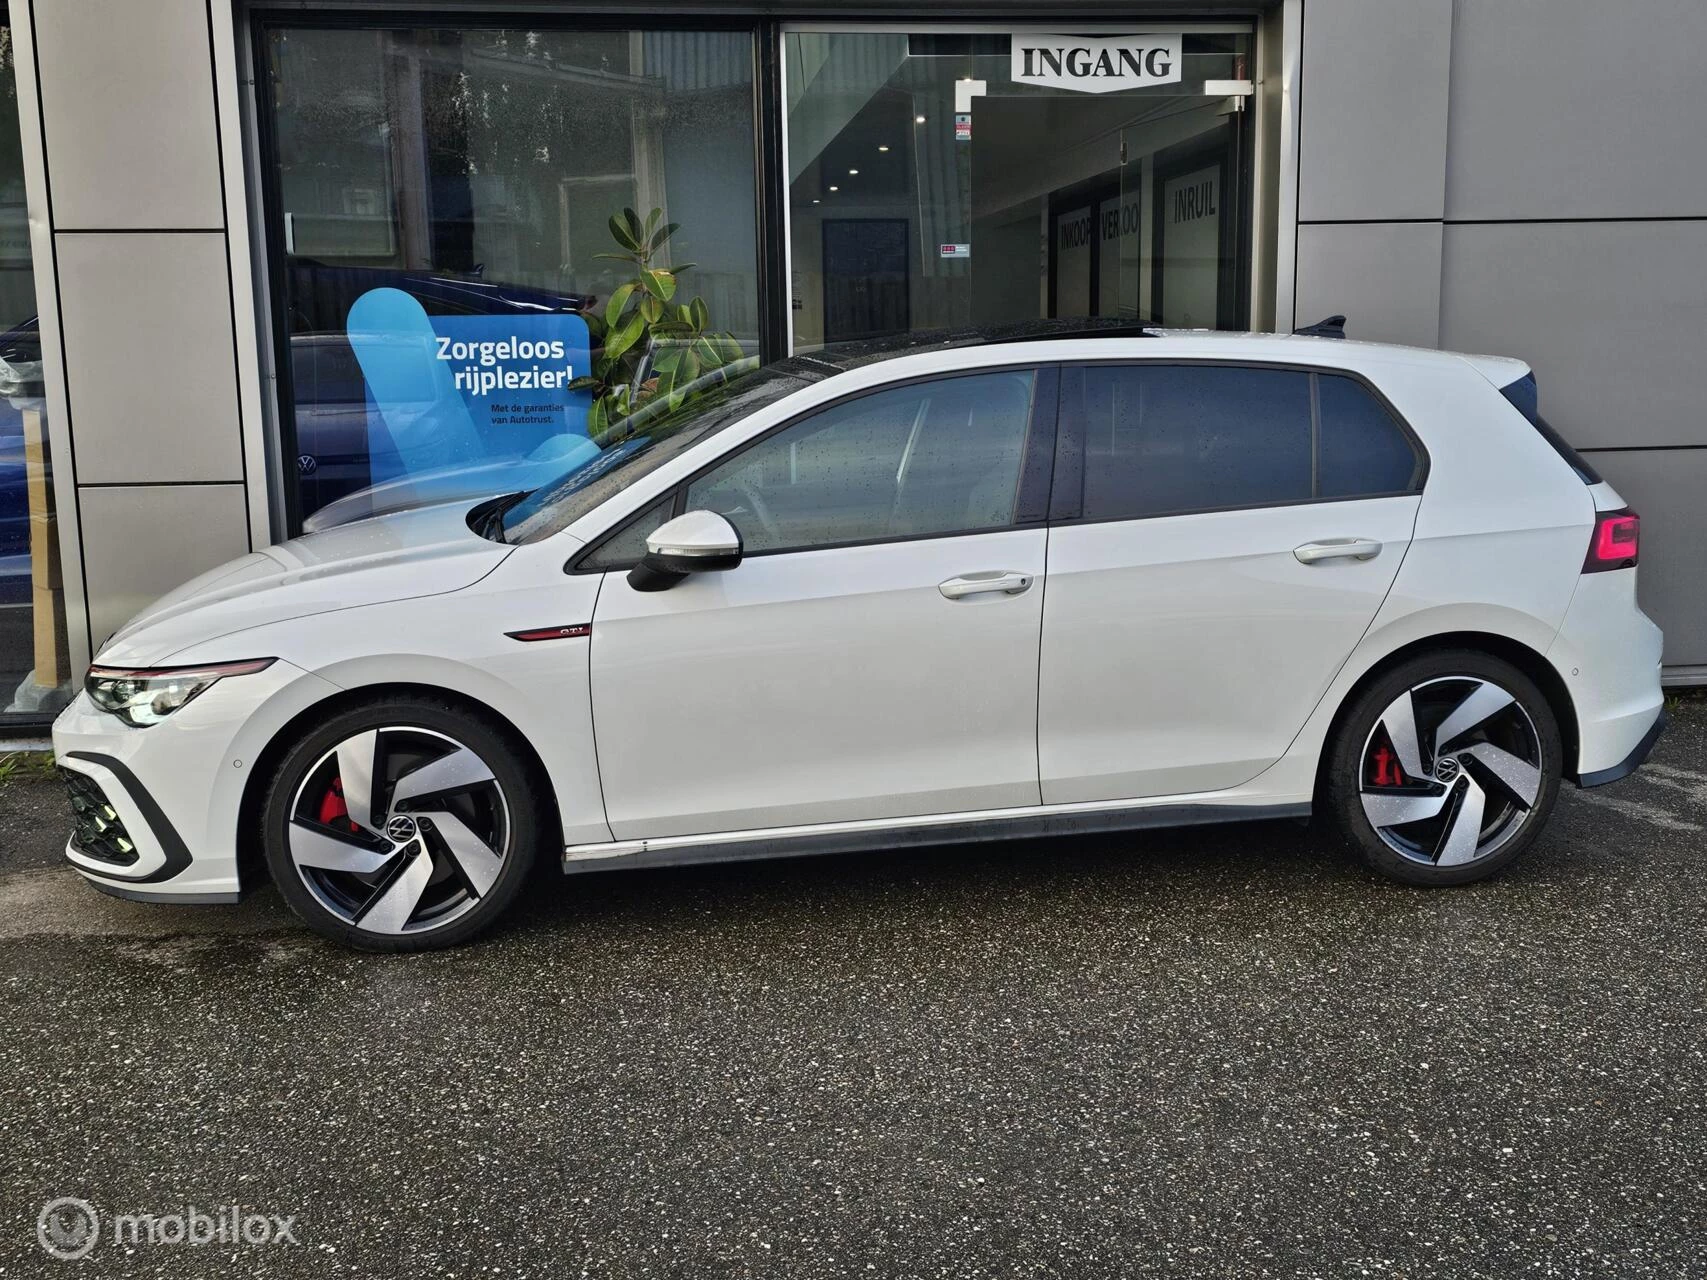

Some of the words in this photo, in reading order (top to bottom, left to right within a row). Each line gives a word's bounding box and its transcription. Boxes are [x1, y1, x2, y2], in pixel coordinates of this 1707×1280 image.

[1020, 47, 1173, 78] INGANG
[1174, 180, 1216, 225] INRUIL
[435, 335, 565, 367] Zorgeloos
[455, 365, 573, 396] rijplezier!
[491, 403, 509, 413] Met
[511, 403, 522, 413] de
[524, 403, 565, 414] garanties
[491, 416, 508, 424] van
[510, 415, 555, 424] Autotrust.
[560, 627, 583, 635] GTI
